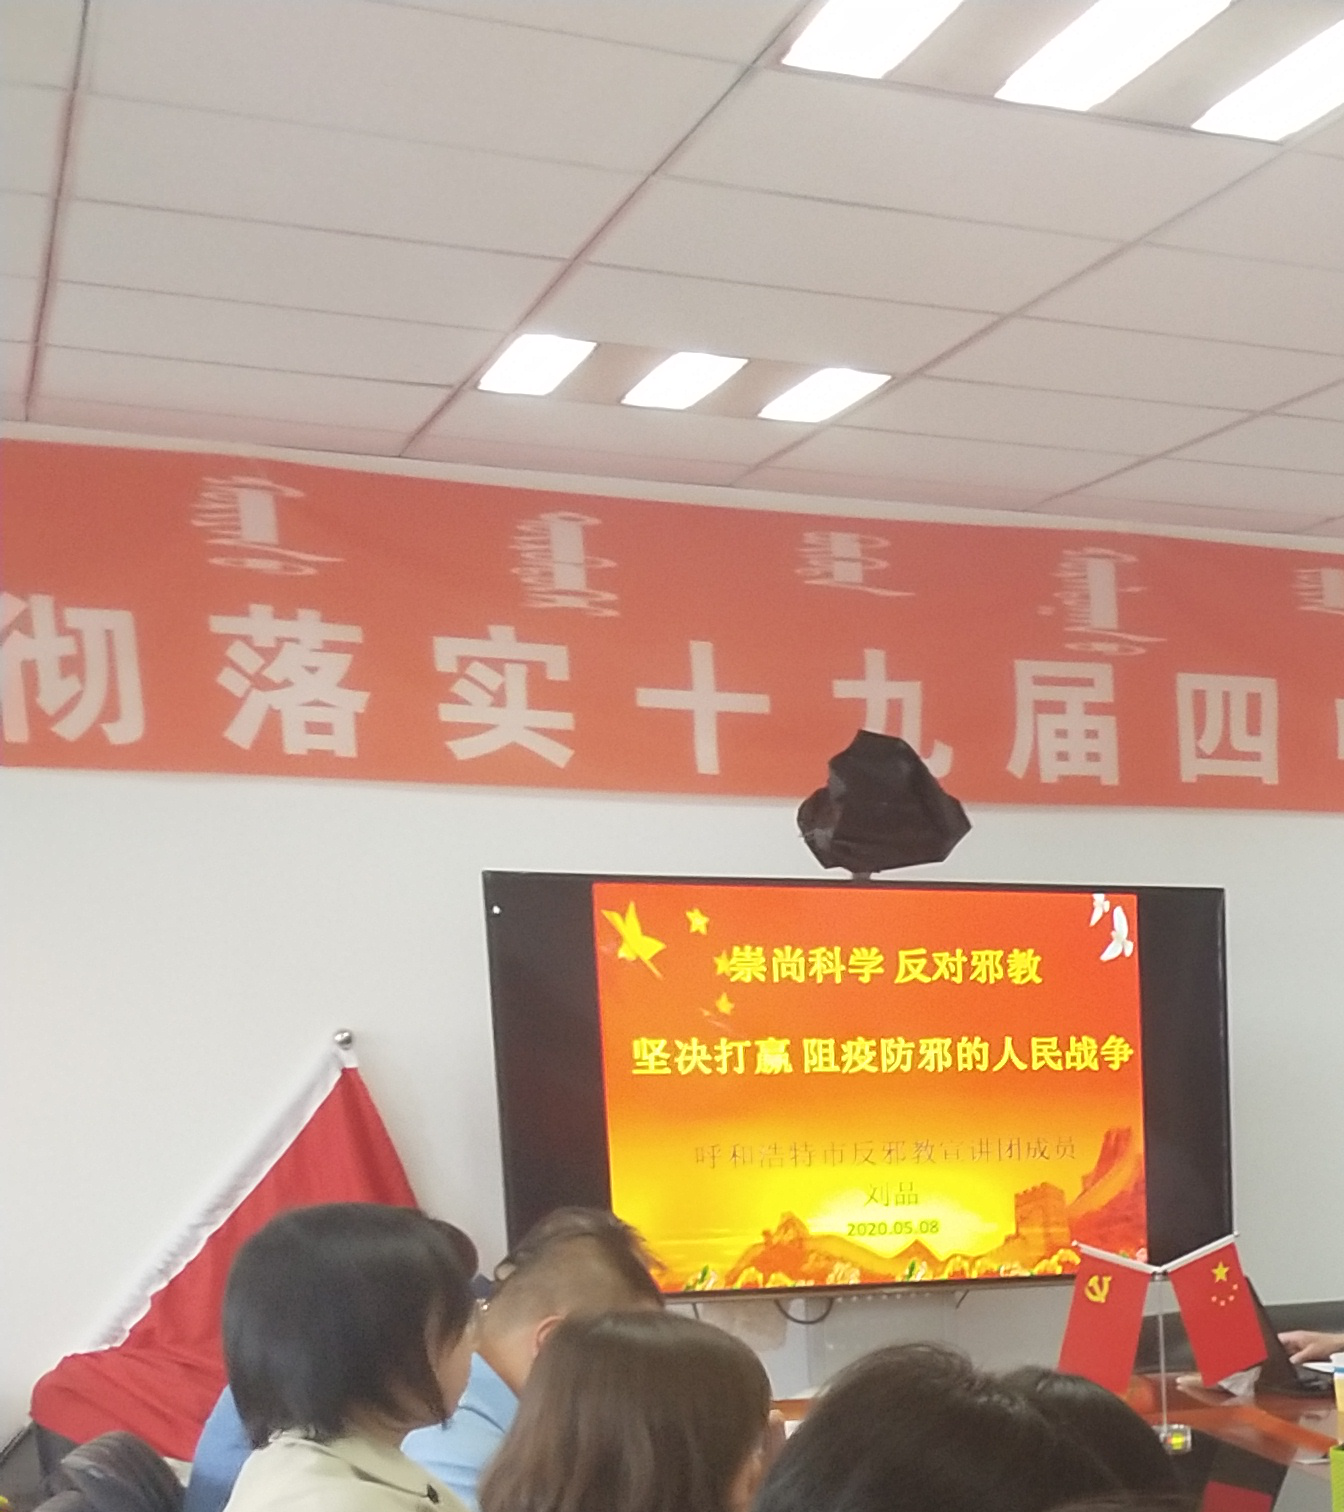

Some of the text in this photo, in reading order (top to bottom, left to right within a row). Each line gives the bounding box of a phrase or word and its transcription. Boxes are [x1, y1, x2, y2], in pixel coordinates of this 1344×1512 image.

[728, 946, 1043, 985] 崇尚科学 反对邪教
[631, 1036, 1134, 1076] 坚决打赢 阻疫防邪的人民战争
[694, 1136, 1077, 1170] 呼和浩特市反邪教宣讲团成员
[864, 1181, 919, 1207] 刘品
[846, 1220, 940, 1237] 2020.05.08
